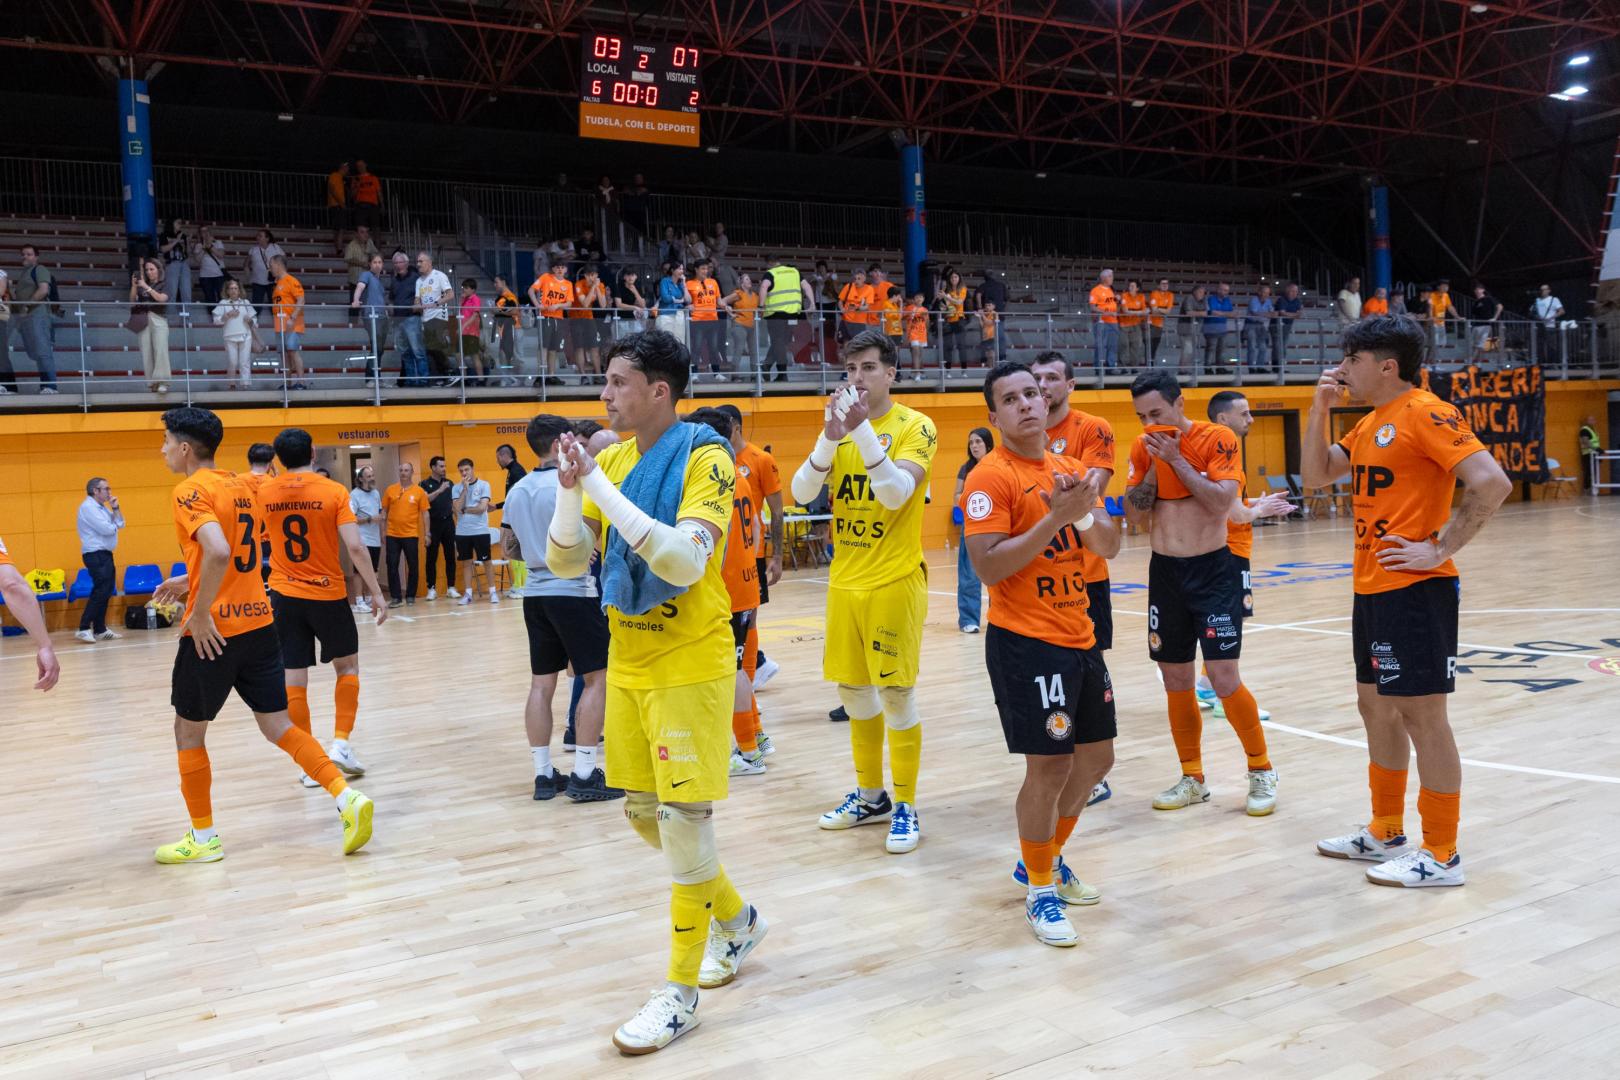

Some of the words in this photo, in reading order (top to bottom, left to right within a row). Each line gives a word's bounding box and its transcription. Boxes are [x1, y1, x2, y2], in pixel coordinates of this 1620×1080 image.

[594, 36, 621, 59] 03
[633, 45, 656, 53] PERIODO
[673, 46, 699, 67] 07
[587, 62, 620, 75] LOCAL
[638, 54, 648, 69] 2
[665, 71, 697, 84] VISITANTE
[592, 80, 602, 95] 6
[613, 82, 658, 106] 00:0
[689, 91, 699, 105] 2
[585, 115, 623, 128] TUDELA,
[625, 119, 644, 129] CON
[645, 121, 655, 130] EL
[657, 122, 696, 134] DEPORTE
[338, 430, 390, 440] vestuarios
[496, 425, 527, 434] conser
[283, 514, 310, 563] 8
[1036, 571, 1086, 598] RIO
[219, 601, 270, 619] uvesa
[1150, 605, 1159, 630] 6
[1034, 673, 1066, 709] 14
